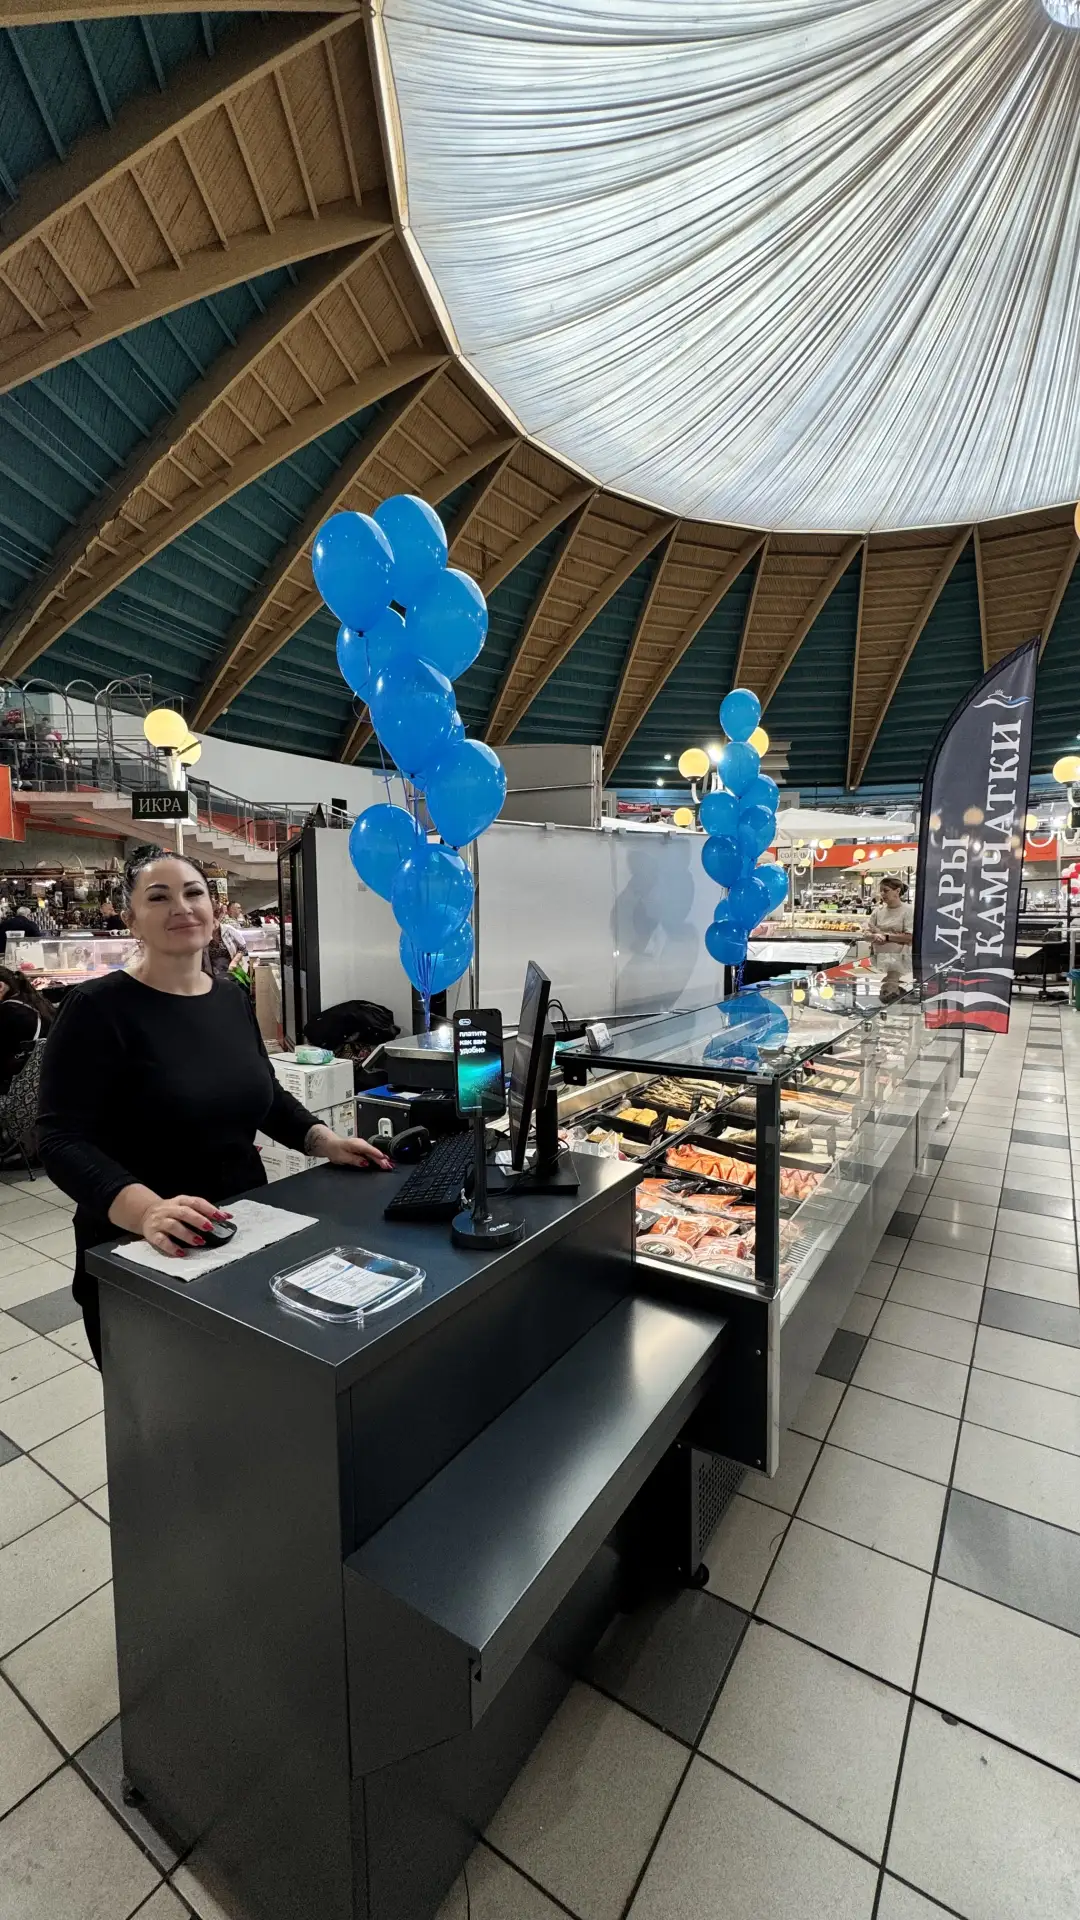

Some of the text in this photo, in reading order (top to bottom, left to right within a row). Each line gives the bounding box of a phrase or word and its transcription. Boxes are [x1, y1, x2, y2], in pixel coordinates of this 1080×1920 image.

[138, 798, 183, 812] ИКРА
[975, 719, 1022, 957] КАМЧАТКИ
[934, 835, 970, 973] ДАРЫ
[459, 1046, 486, 1056] удобно
